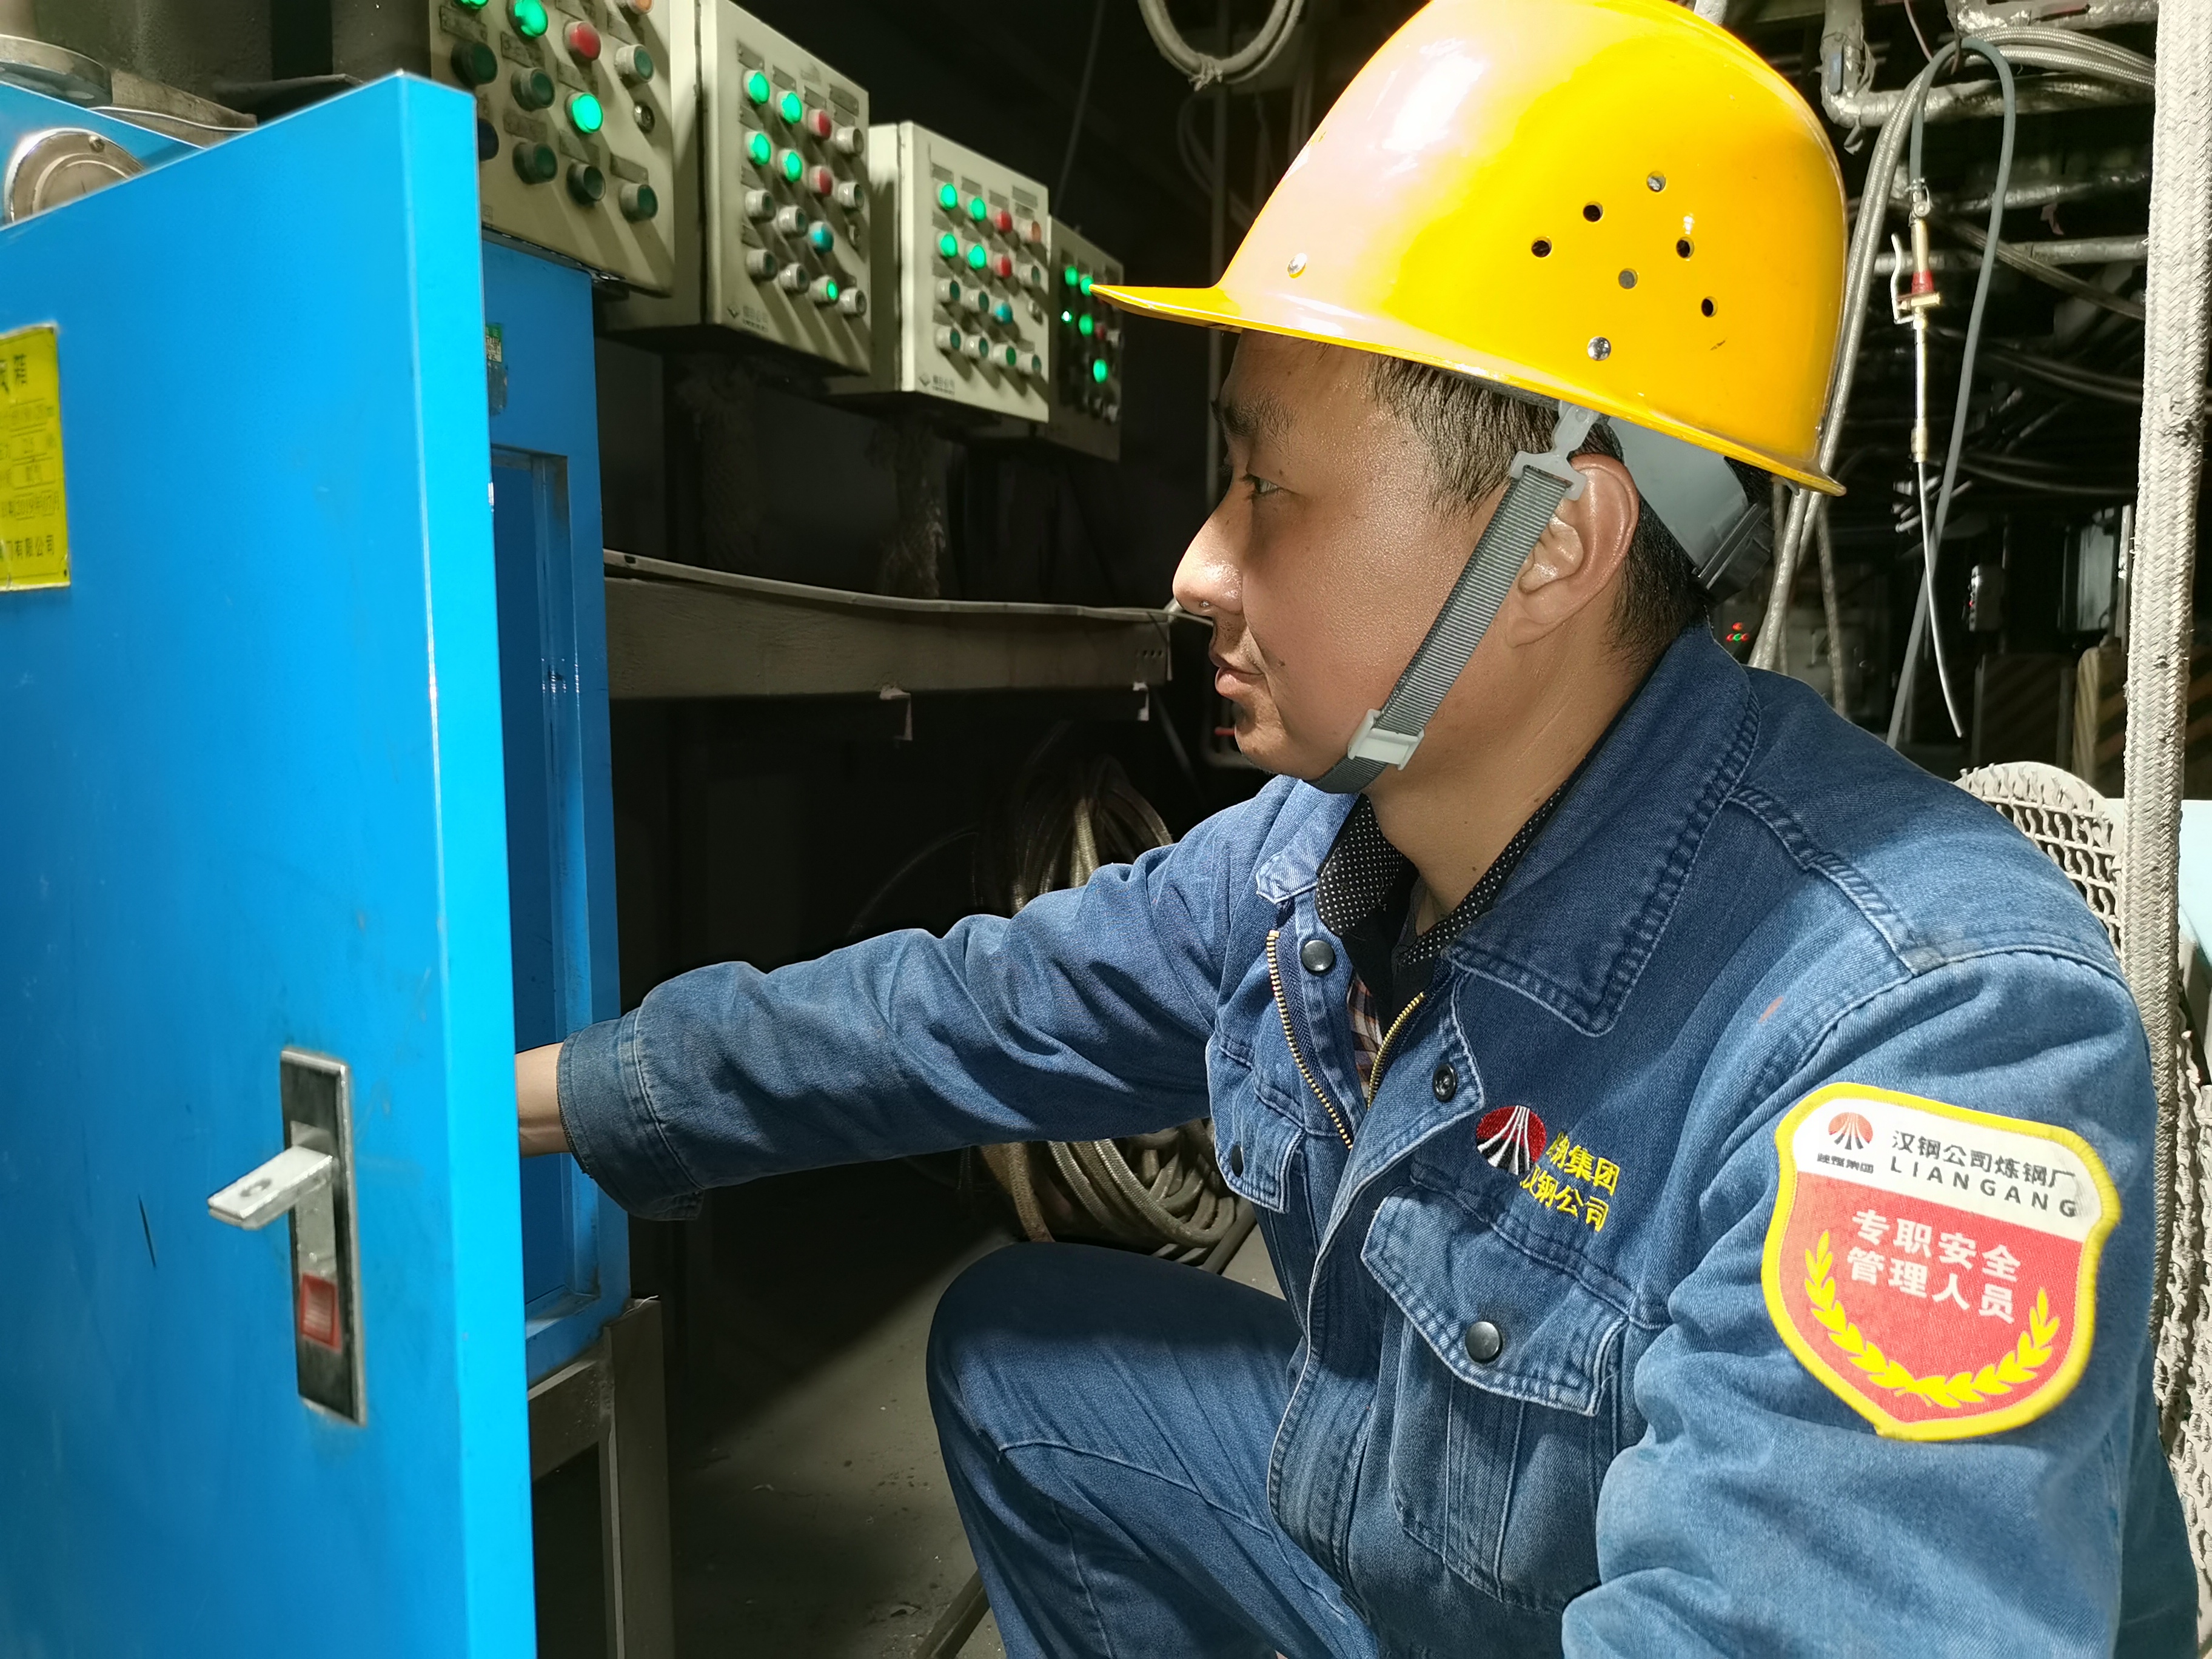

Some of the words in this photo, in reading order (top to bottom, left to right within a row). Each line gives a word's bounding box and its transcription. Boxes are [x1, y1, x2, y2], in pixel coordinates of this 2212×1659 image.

[1891, 1156, 2077, 1218] LIANGANG
[1892, 1130, 2076, 1188] 汉钢公司炼钢厂
[1851, 1208, 2021, 1282] 专职安全
[1847, 1246, 2015, 1324] 管理人员
